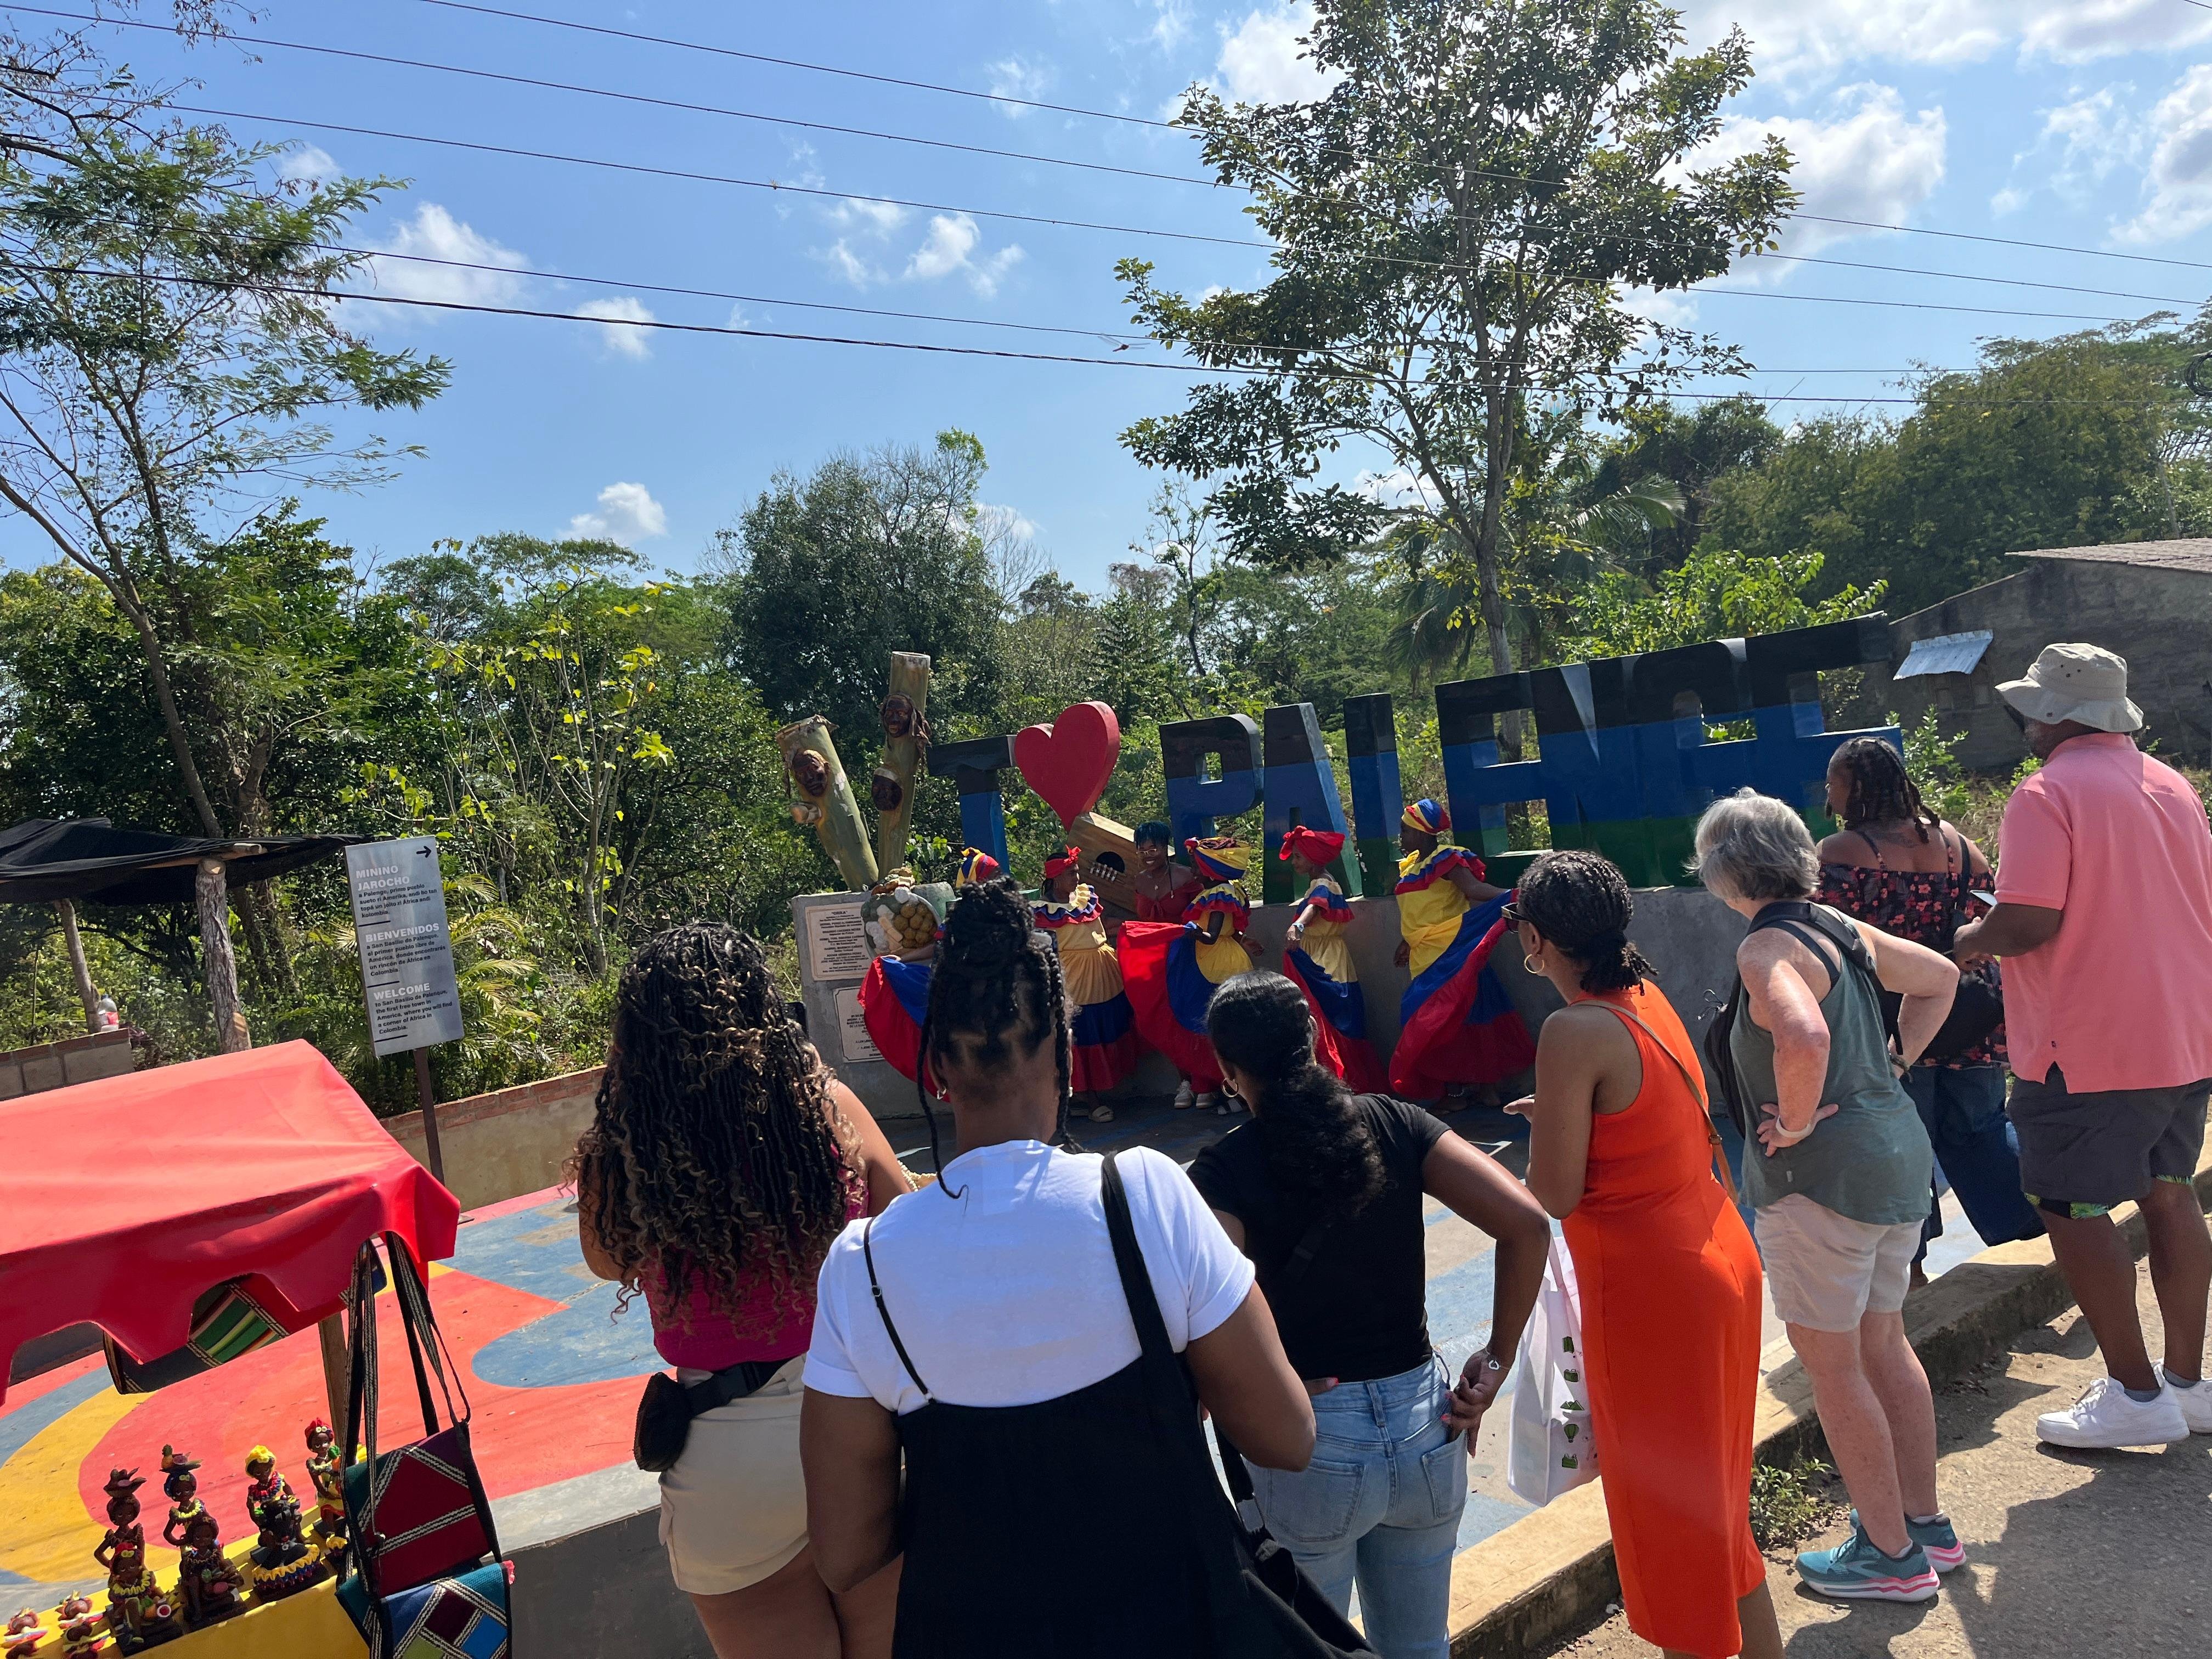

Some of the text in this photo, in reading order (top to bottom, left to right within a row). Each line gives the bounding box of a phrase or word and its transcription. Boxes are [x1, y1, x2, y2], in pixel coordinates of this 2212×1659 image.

[356, 865, 398, 878] MININO
[358, 876, 410, 891] JAROCHO
[365, 923, 439, 943] BIENVENIDOS
[415, 946, 445, 955] encontrarás
[374, 983, 430, 1000] WELCOME
